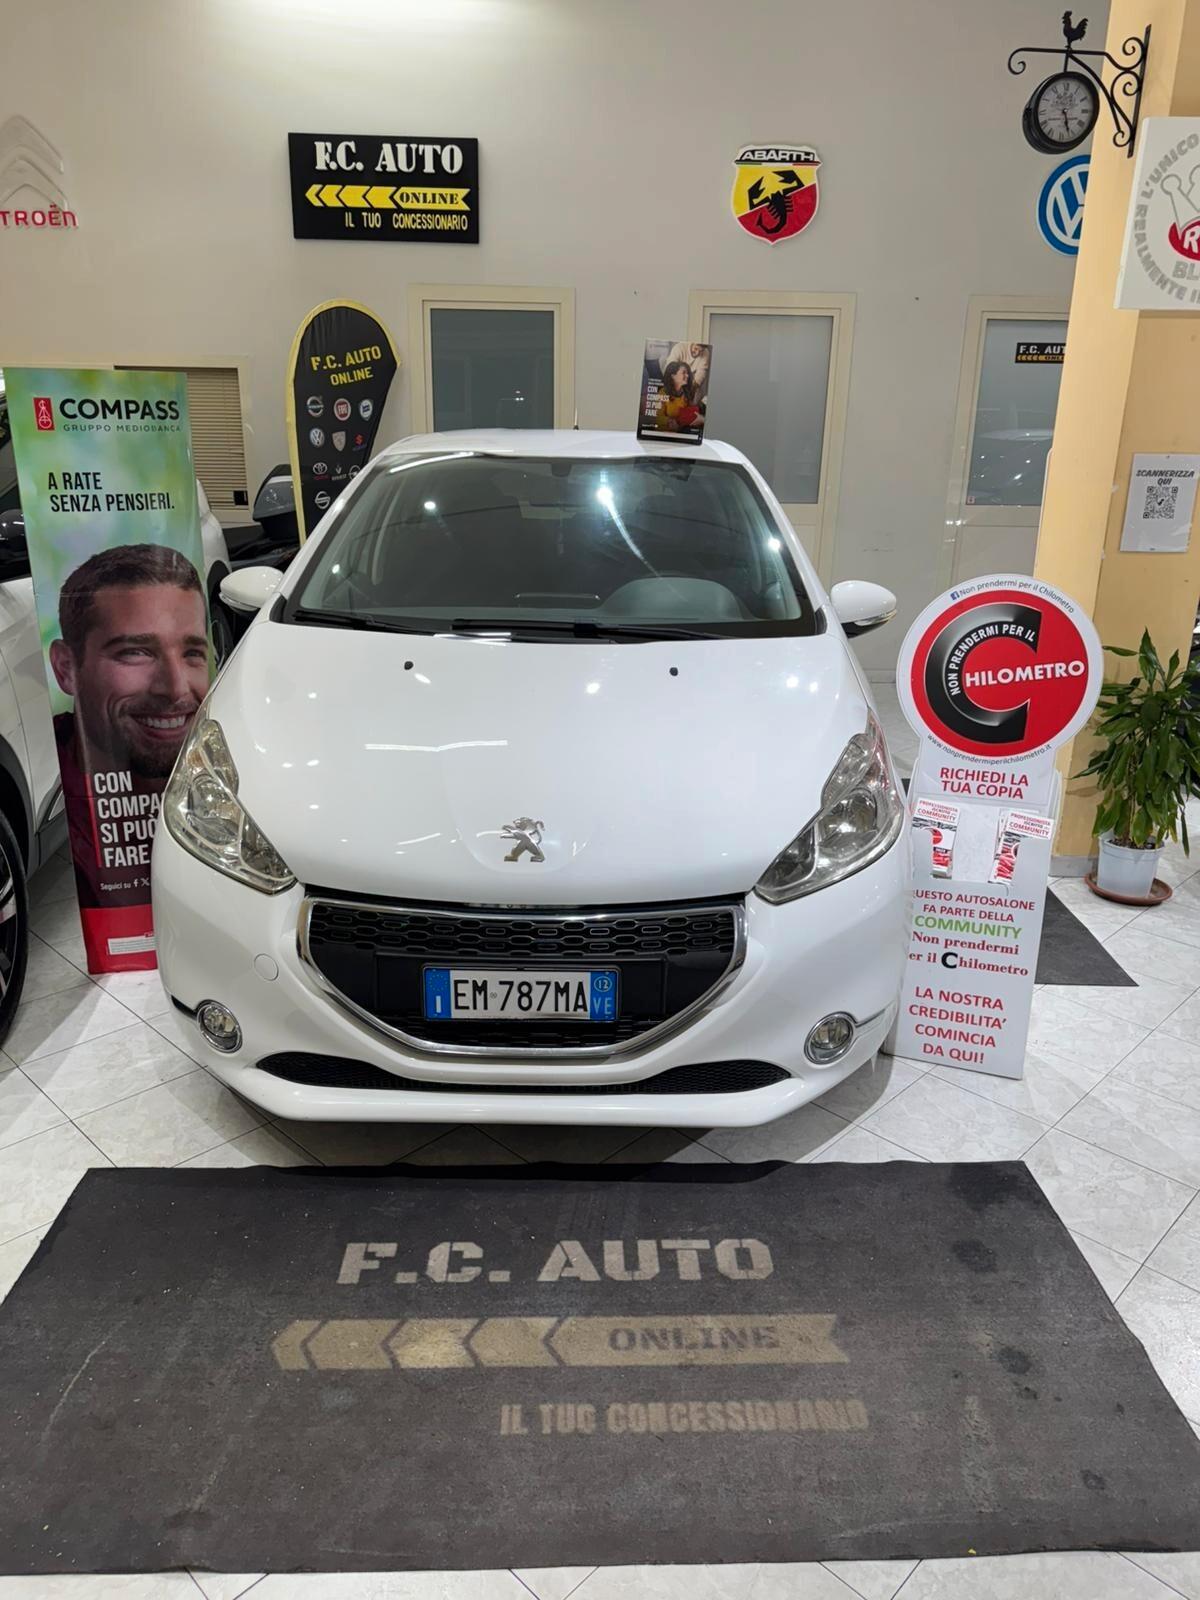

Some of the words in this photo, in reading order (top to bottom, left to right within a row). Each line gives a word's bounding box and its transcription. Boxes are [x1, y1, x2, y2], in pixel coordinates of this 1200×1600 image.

[313, 140, 364, 171] F.C.
[375, 142, 463, 174] AUTO
[741, 150, 814, 161] ABARTH
[1141, 133, 1200, 200] L'UNICO
[399, 191, 459, 205] ONLINE
[345, 212, 355, 228] IL
[362, 212, 381, 229] TUO
[392, 213, 468, 231] CONCESSIONARIO
[1183, 224, 1200, 254] R
[1134, 204, 1187, 301] REALMENTE
[1172, 261, 1200, 281] BL
[311, 355, 342, 371] F.C.
[345, 345, 381, 366] AUTO
[1019, 345, 1040, 354] F.C.
[1044, 345, 1065, 354] AU
[330, 367, 374, 385] ONLINE
[59, 398, 180, 420] COMPASS
[63, 423, 111, 432] GRUPPO
[116, 424, 181, 433] MEDIOBANCA
[48, 472, 58, 490] A
[62, 472, 102, 490] RATE
[1136, 469, 1195, 478] SCANNERIZZA
[1157, 478, 1173, 486] QUI
[50, 494, 102, 512] SENZA
[105, 492, 175, 512] PENSIERI.
[959, 586, 976, 595] Non
[977, 579, 1017, 591] prendermi
[1018, 581, 1032, 589] per
[1039, 586, 1075, 613] Chilometro
[1002, 624, 1024, 636] PER
[1024, 629, 1036, 642] IL
[948, 625, 999, 670] PRENDERMI
[948, 673, 961, 696] NON
[94, 771, 132, 794] CON
[940, 767, 1006, 784] RICHIEDI
[1010, 773, 1029, 786] LA
[941, 780, 972, 794] TUA
[976, 784, 1024, 799] COPIA
[97, 792, 165, 819] COMPA
[917, 808, 956, 821] COMMUNITY
[100, 822, 118, 844] SI
[123, 814, 157, 842] PUÒ
[1009, 822, 1049, 835] COMMUNITY
[104, 844, 151, 868] FARE
[100, 881, 122, 891] Seguici
[913, 889, 953, 901] UESTO
[955, 894, 1036, 911] AUTOSALONE
[923, 904, 936, 914] FA
[940, 905, 975, 918] PARTE
[979, 910, 1014, 922] DELLA
[914, 915, 1022, 939] COMMUNITY
[912, 931, 940, 945] Non
[943, 938, 1019, 955] prendermi
[909, 952, 923, 961] er
[927, 952, 937, 963] il
[940, 951, 1028, 977] Chilometro
[597, 979, 609, 990] 12
[453, 979, 488, 1010] EM
[499, 981, 589, 1013] 787MA
[593, 997, 612, 1015] VE
[915, 986, 934, 1000] LA
[938, 990, 1004, 1011] NOSTRA
[909, 1004, 1007, 1030] CREDIBILITA'
[915, 1023, 996, 1048] COMINCIA
[922, 1043, 944, 1057] DA
[949, 1048, 985, 1064] QUI!
[335, 1241, 511, 1286] F.C.
[536, 1238, 775, 1283] AUTO
[607, 1325, 781, 1352] ONLINE
[500, 1403, 528, 1435] IL
